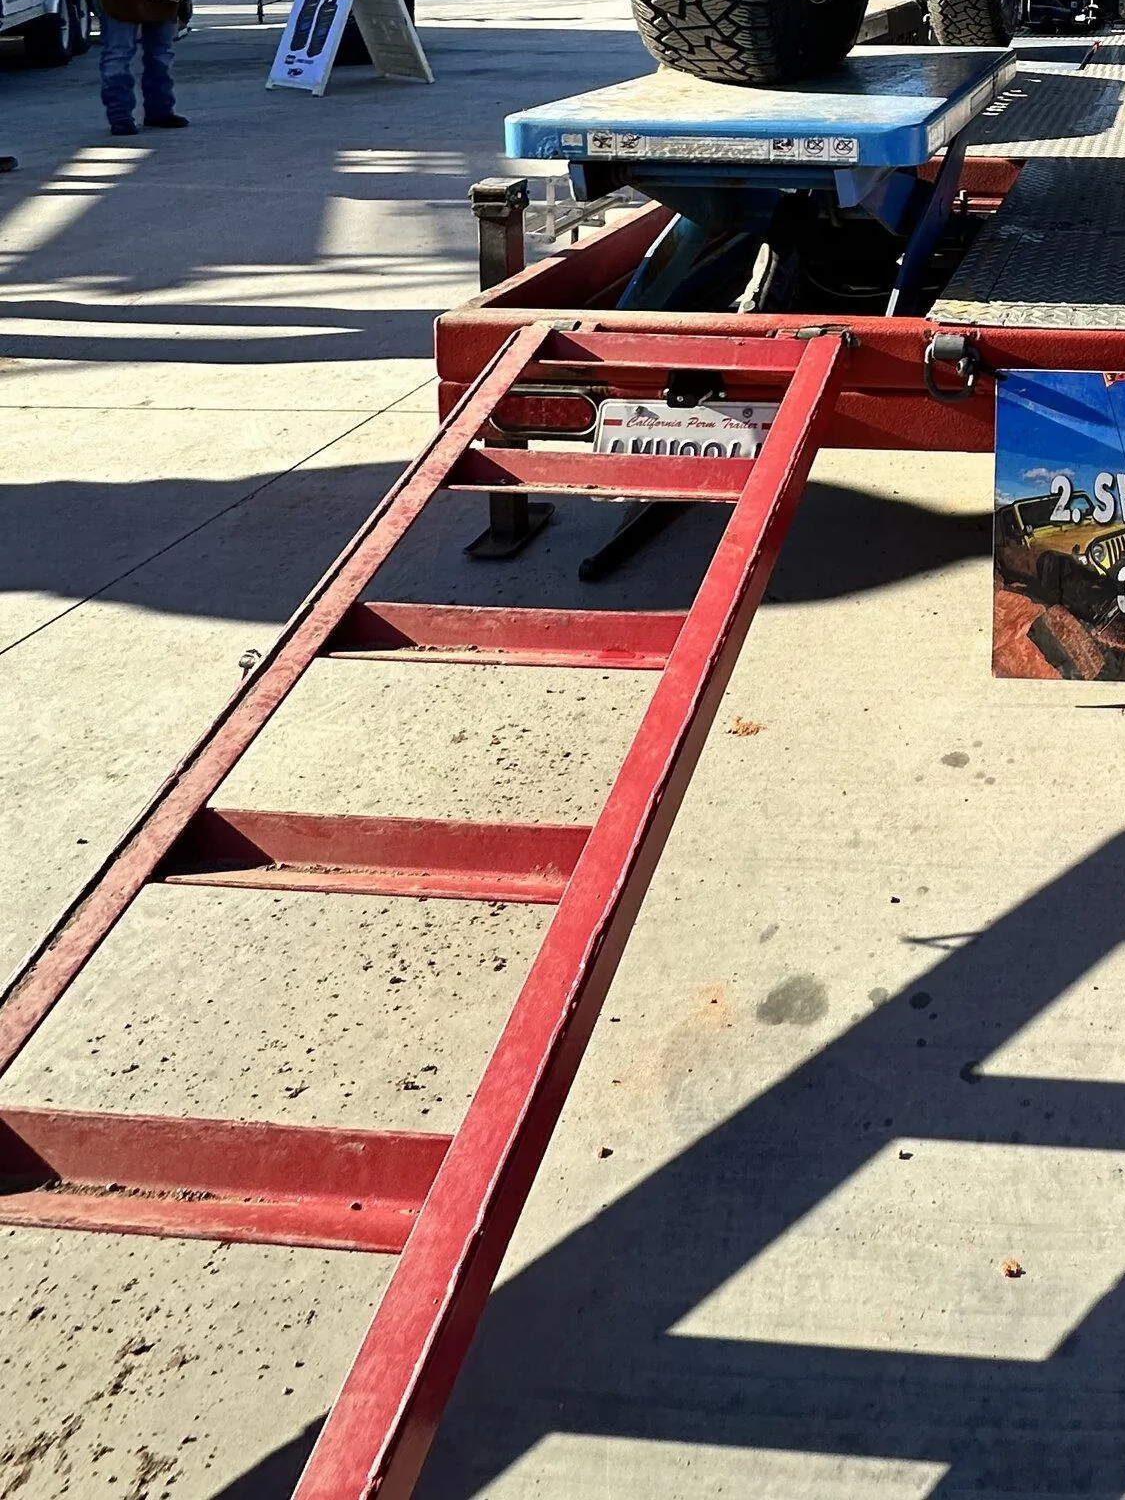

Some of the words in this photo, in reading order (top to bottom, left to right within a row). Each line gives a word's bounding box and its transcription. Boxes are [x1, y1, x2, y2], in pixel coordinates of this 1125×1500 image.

[626, 416, 682, 430] California
[686, 417, 716, 429] Perm
[722, 418, 758, 430] Trailer
[1049, 475, 1081, 524] 2.
